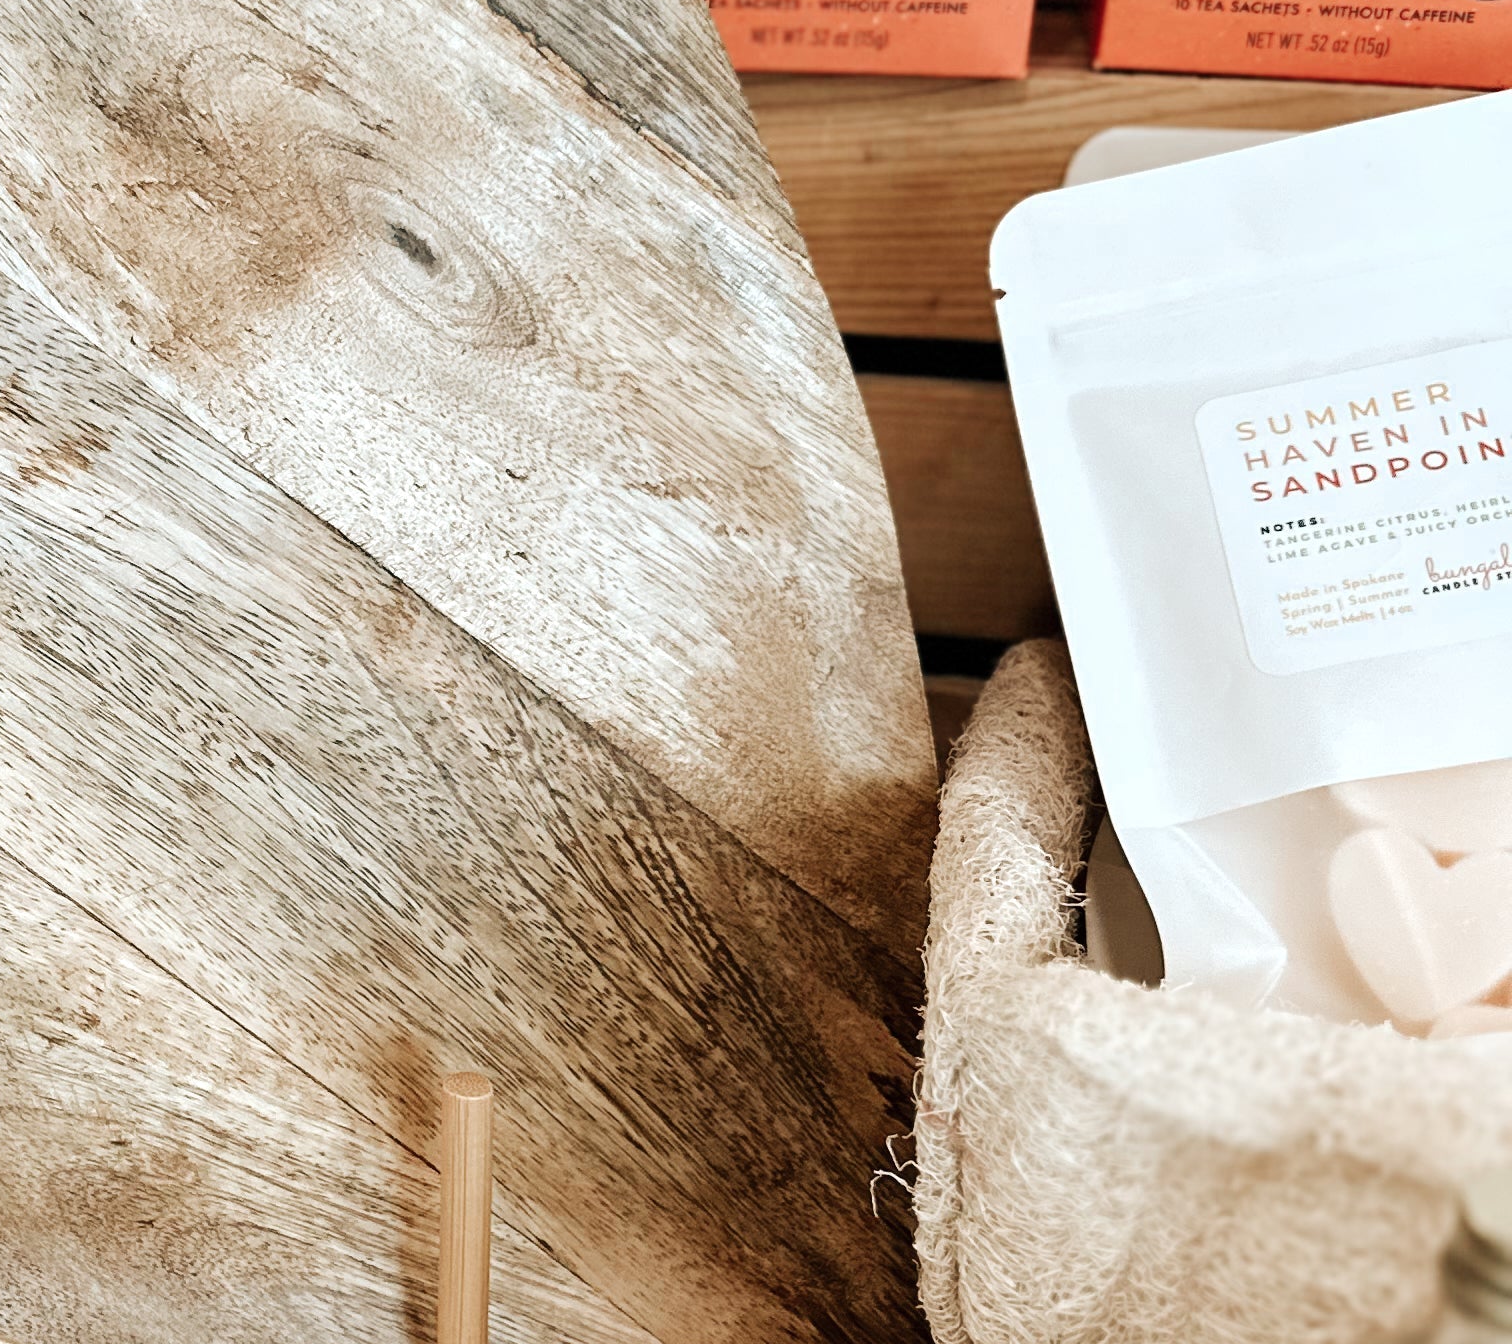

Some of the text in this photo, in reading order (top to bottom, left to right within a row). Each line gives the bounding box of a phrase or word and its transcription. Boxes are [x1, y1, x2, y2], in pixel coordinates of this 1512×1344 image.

[819, 0, 890, 14] WITHOUT
[895, 0, 969, 14] CAFFEINE
[1197, 0, 1224, 12] TEA
[1230, 0, 1300, 15] SACHETS
[1318, 5, 1394, 20] WITHOUT
[1399, 7, 1476, 24] CAFFEINE
[1245, 31, 1391, 58] NET WT .52 oz (15g)
[1235, 382, 1451, 441] SUMMER
[1243, 408, 1488, 471] HAVEN IN
[1251, 435, 1512, 502] SANDPOIN
[1260, 516, 1326, 535] NOTES:
[1267, 548, 1309, 564] LIME
[1405, 519, 1457, 537] JUICY
[1278, 572, 1405, 603] Made in Spokane
[1422, 578, 1479, 595] CANDLE
[1281, 603, 1332, 620] Spring
[1348, 588, 1409, 605] Summer
